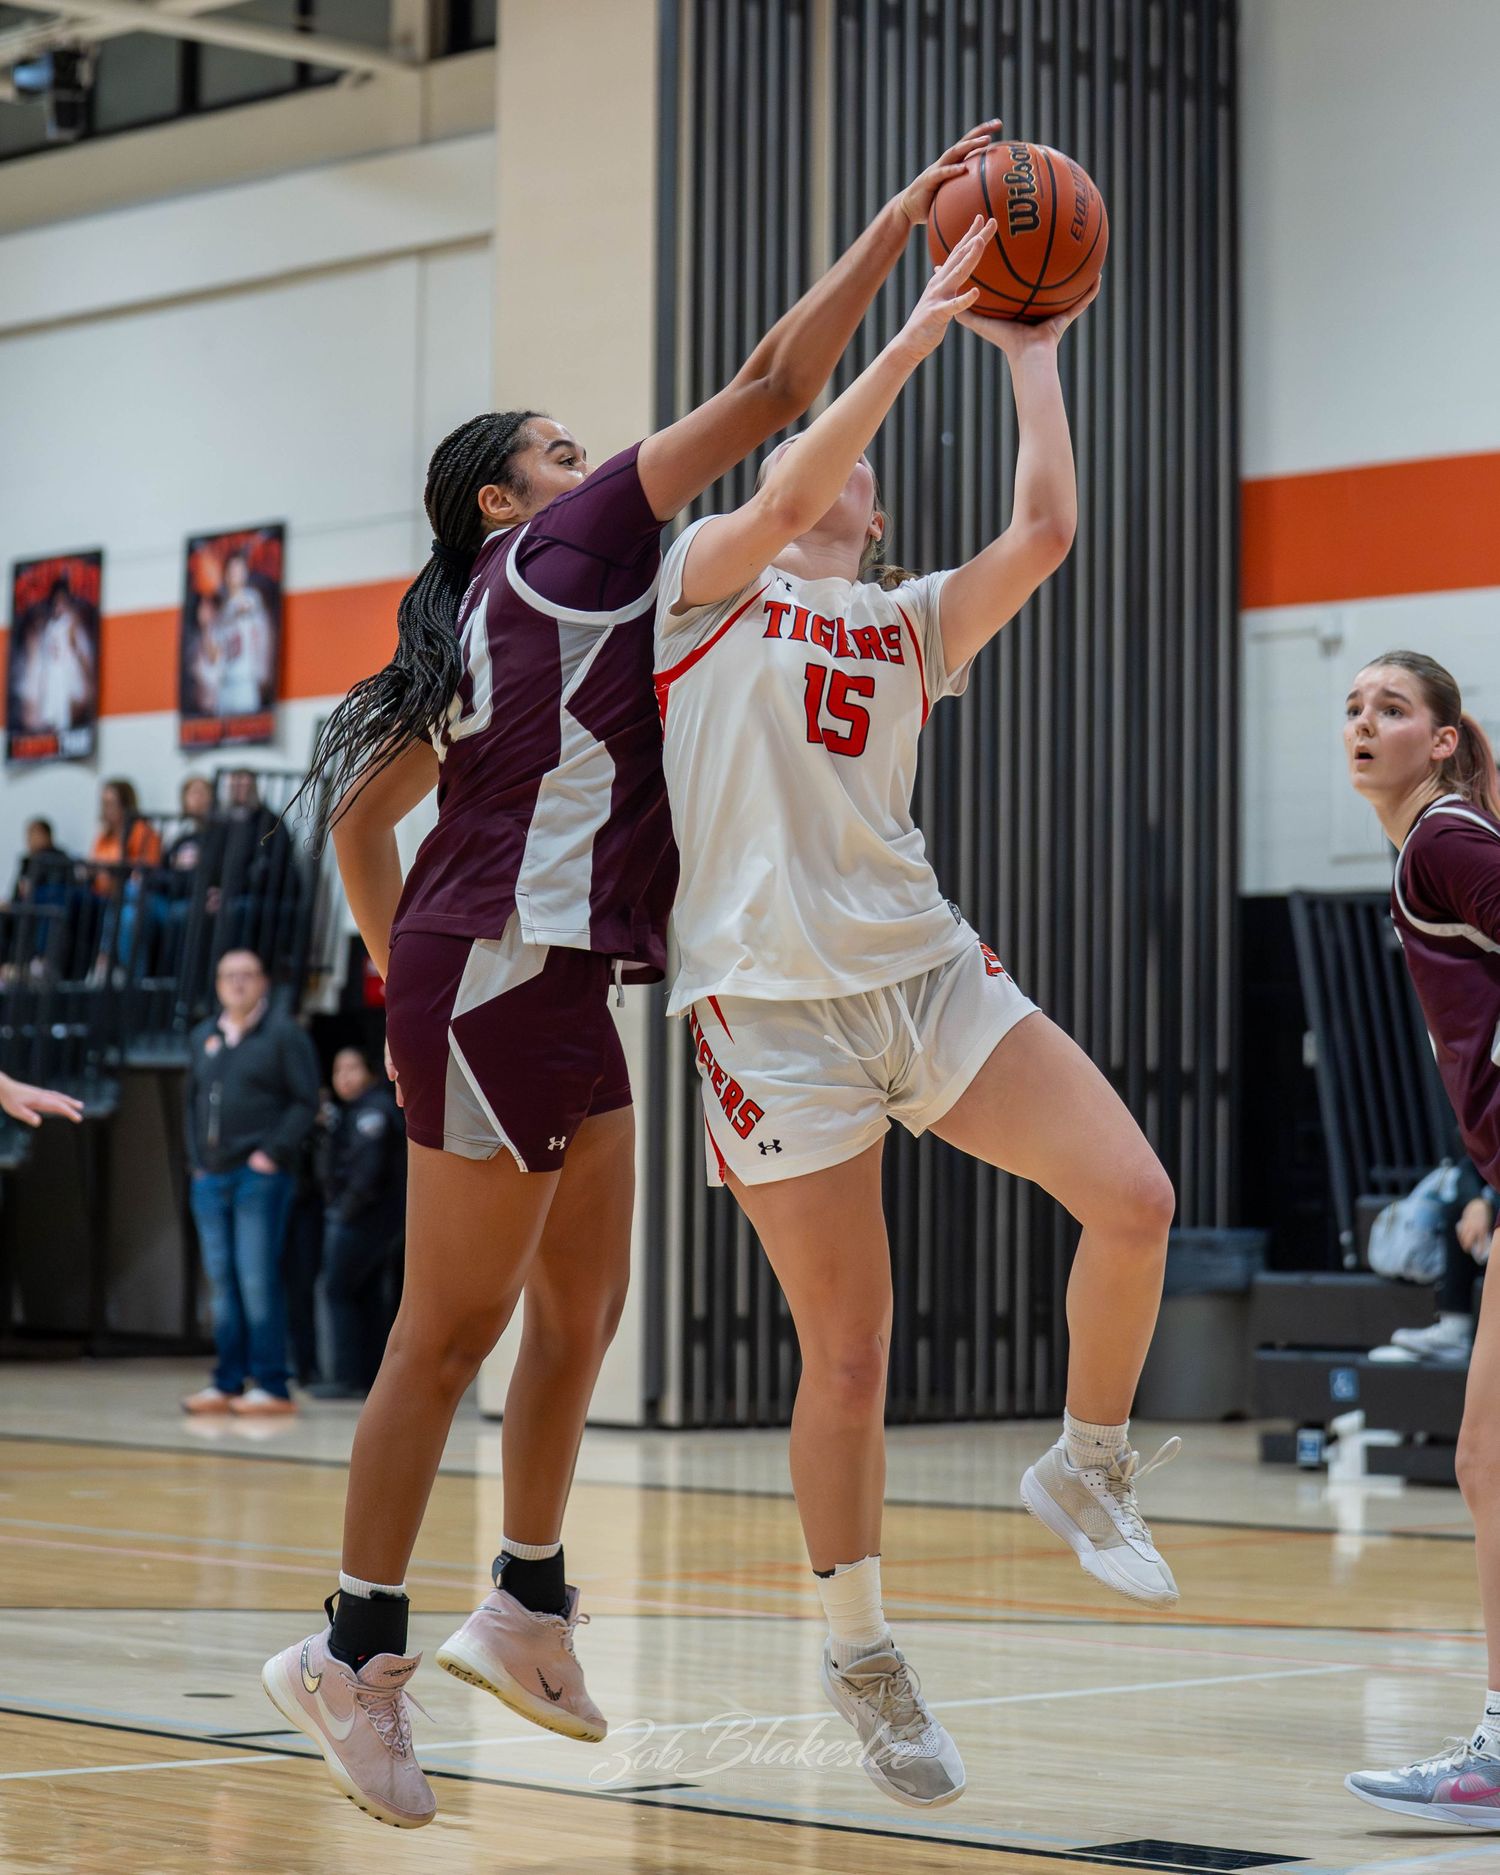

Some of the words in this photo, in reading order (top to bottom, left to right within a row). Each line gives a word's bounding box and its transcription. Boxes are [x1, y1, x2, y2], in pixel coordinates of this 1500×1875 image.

[1003, 143, 1040, 236] Wilson
[762, 600, 905, 666] TIGERS
[804, 662, 876, 758] 15
